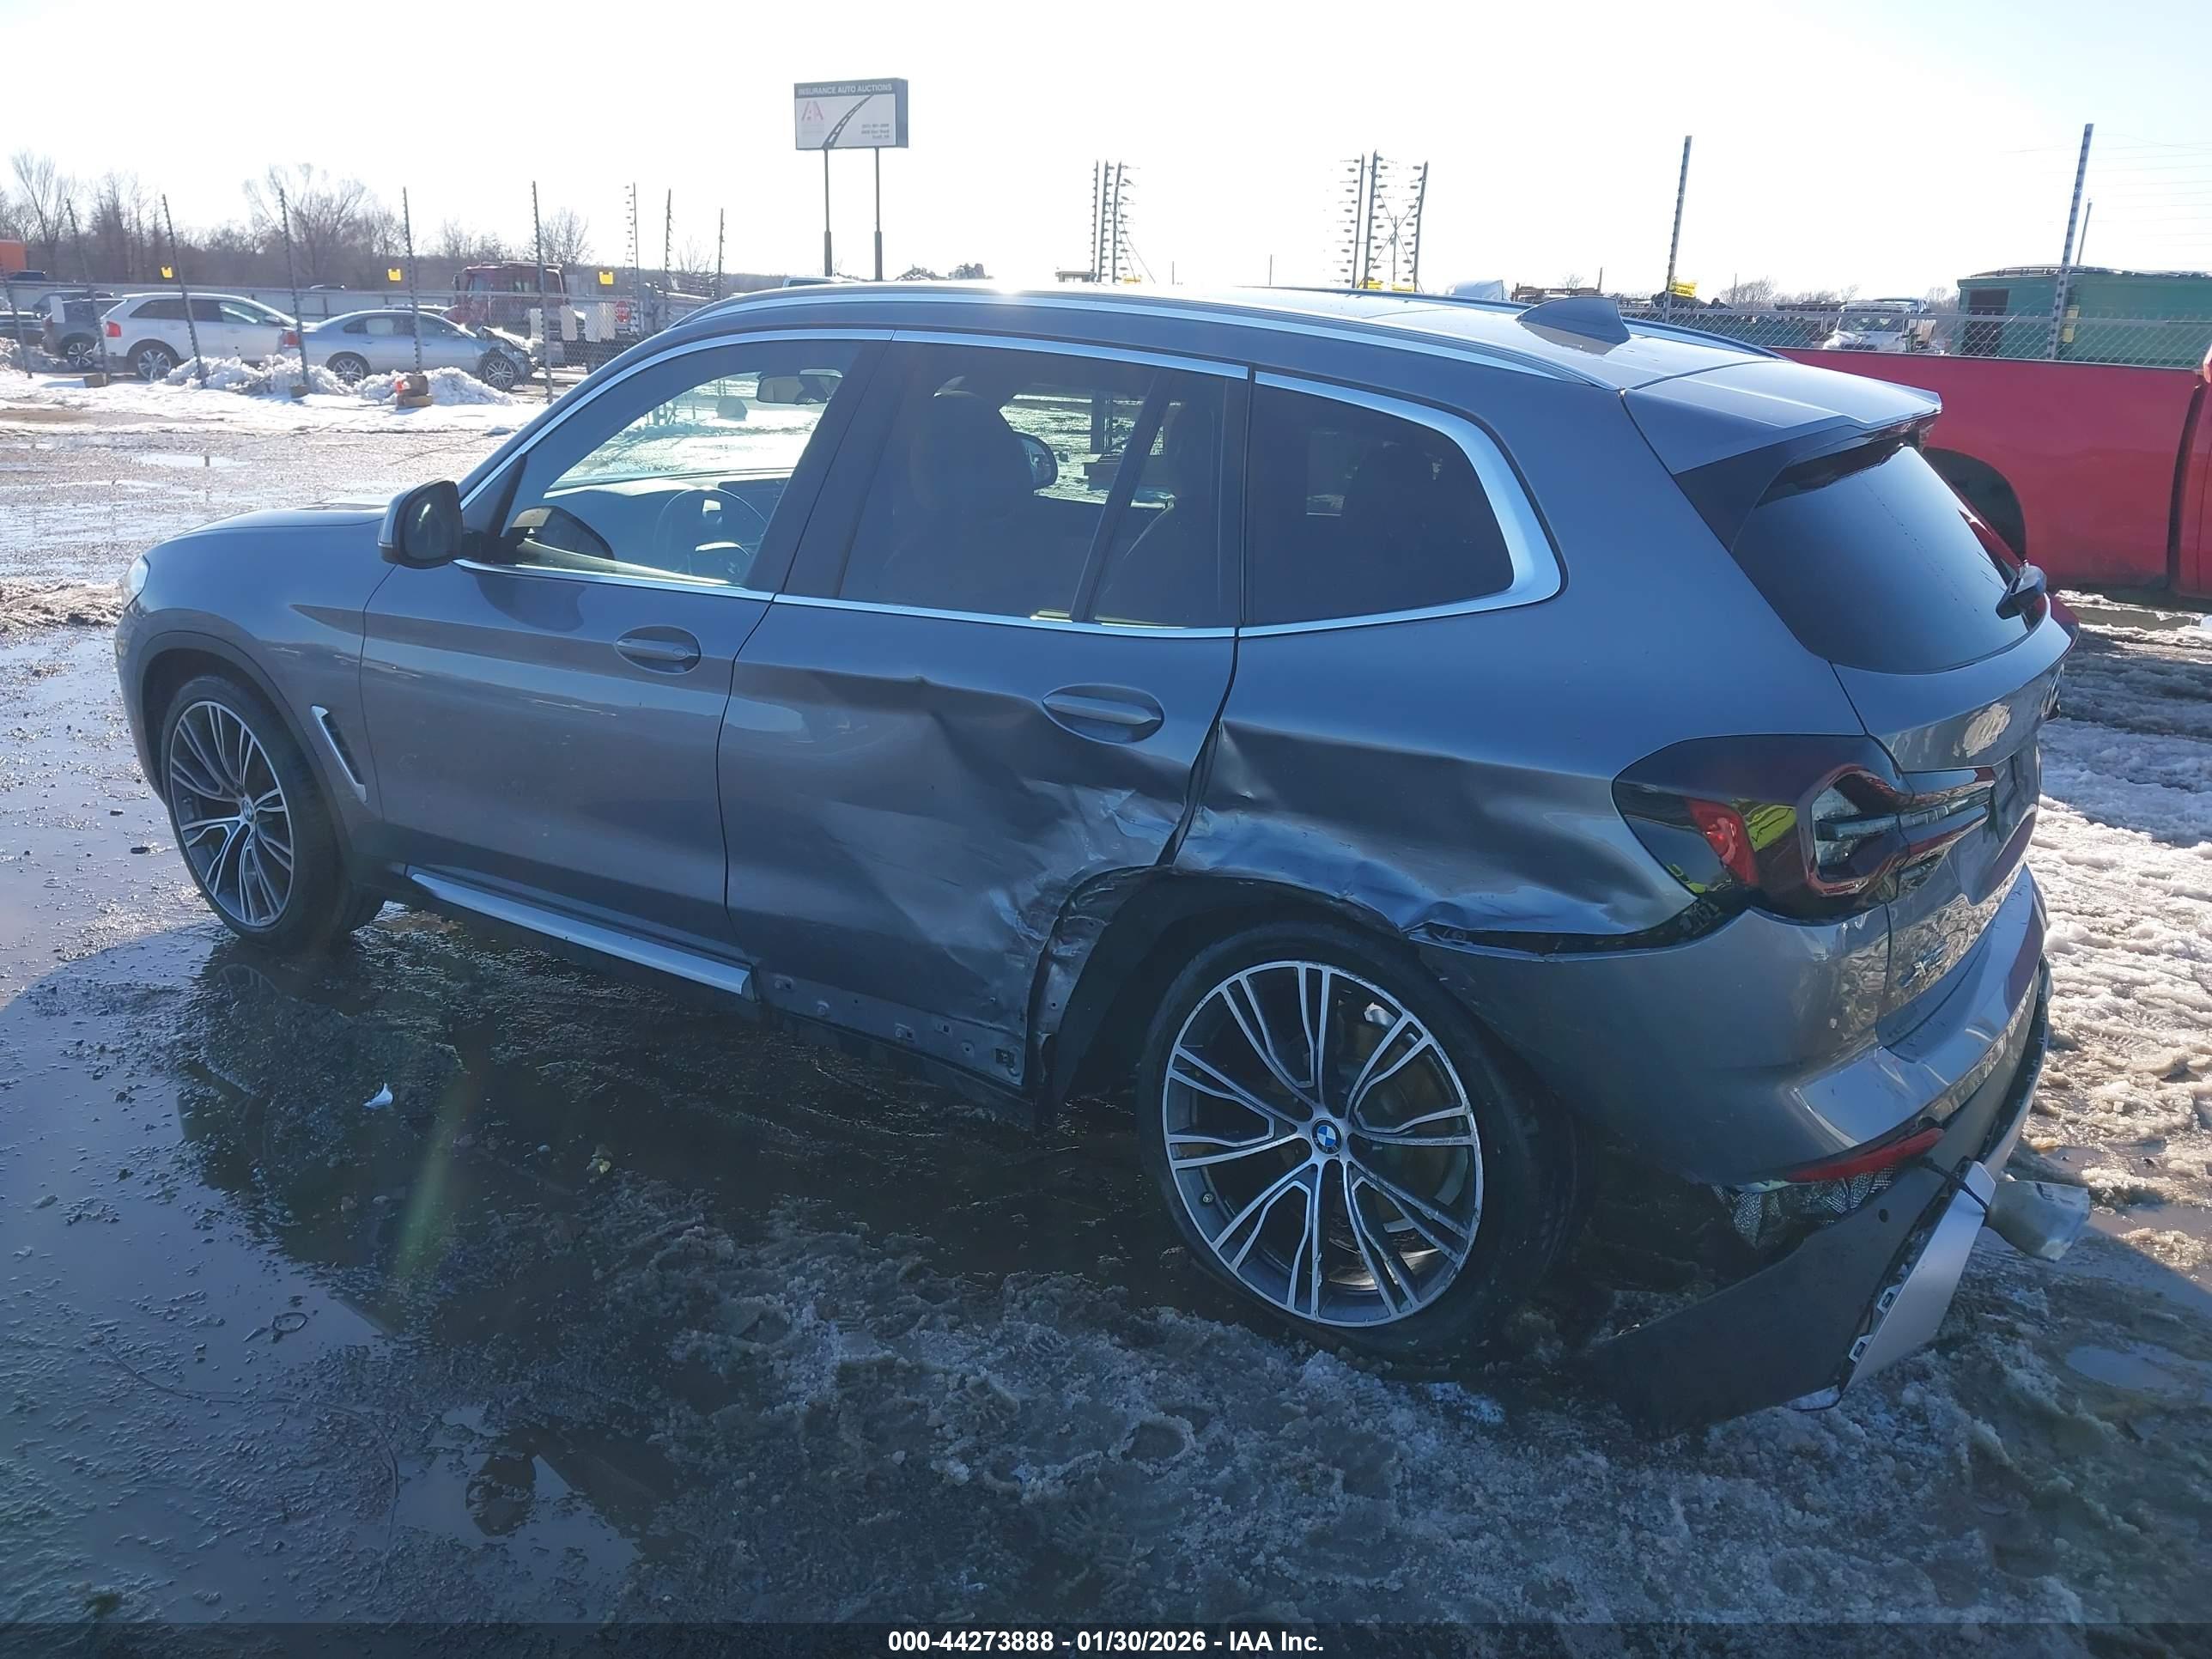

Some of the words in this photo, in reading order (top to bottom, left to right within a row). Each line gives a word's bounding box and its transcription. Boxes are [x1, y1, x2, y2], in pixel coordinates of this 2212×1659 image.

[798, 86, 836, 95] INSURANCE
[837, 84, 856, 94] AUTO
[857, 82, 892, 93] AUCTIONS
[615, 307, 630, 317] STOP
